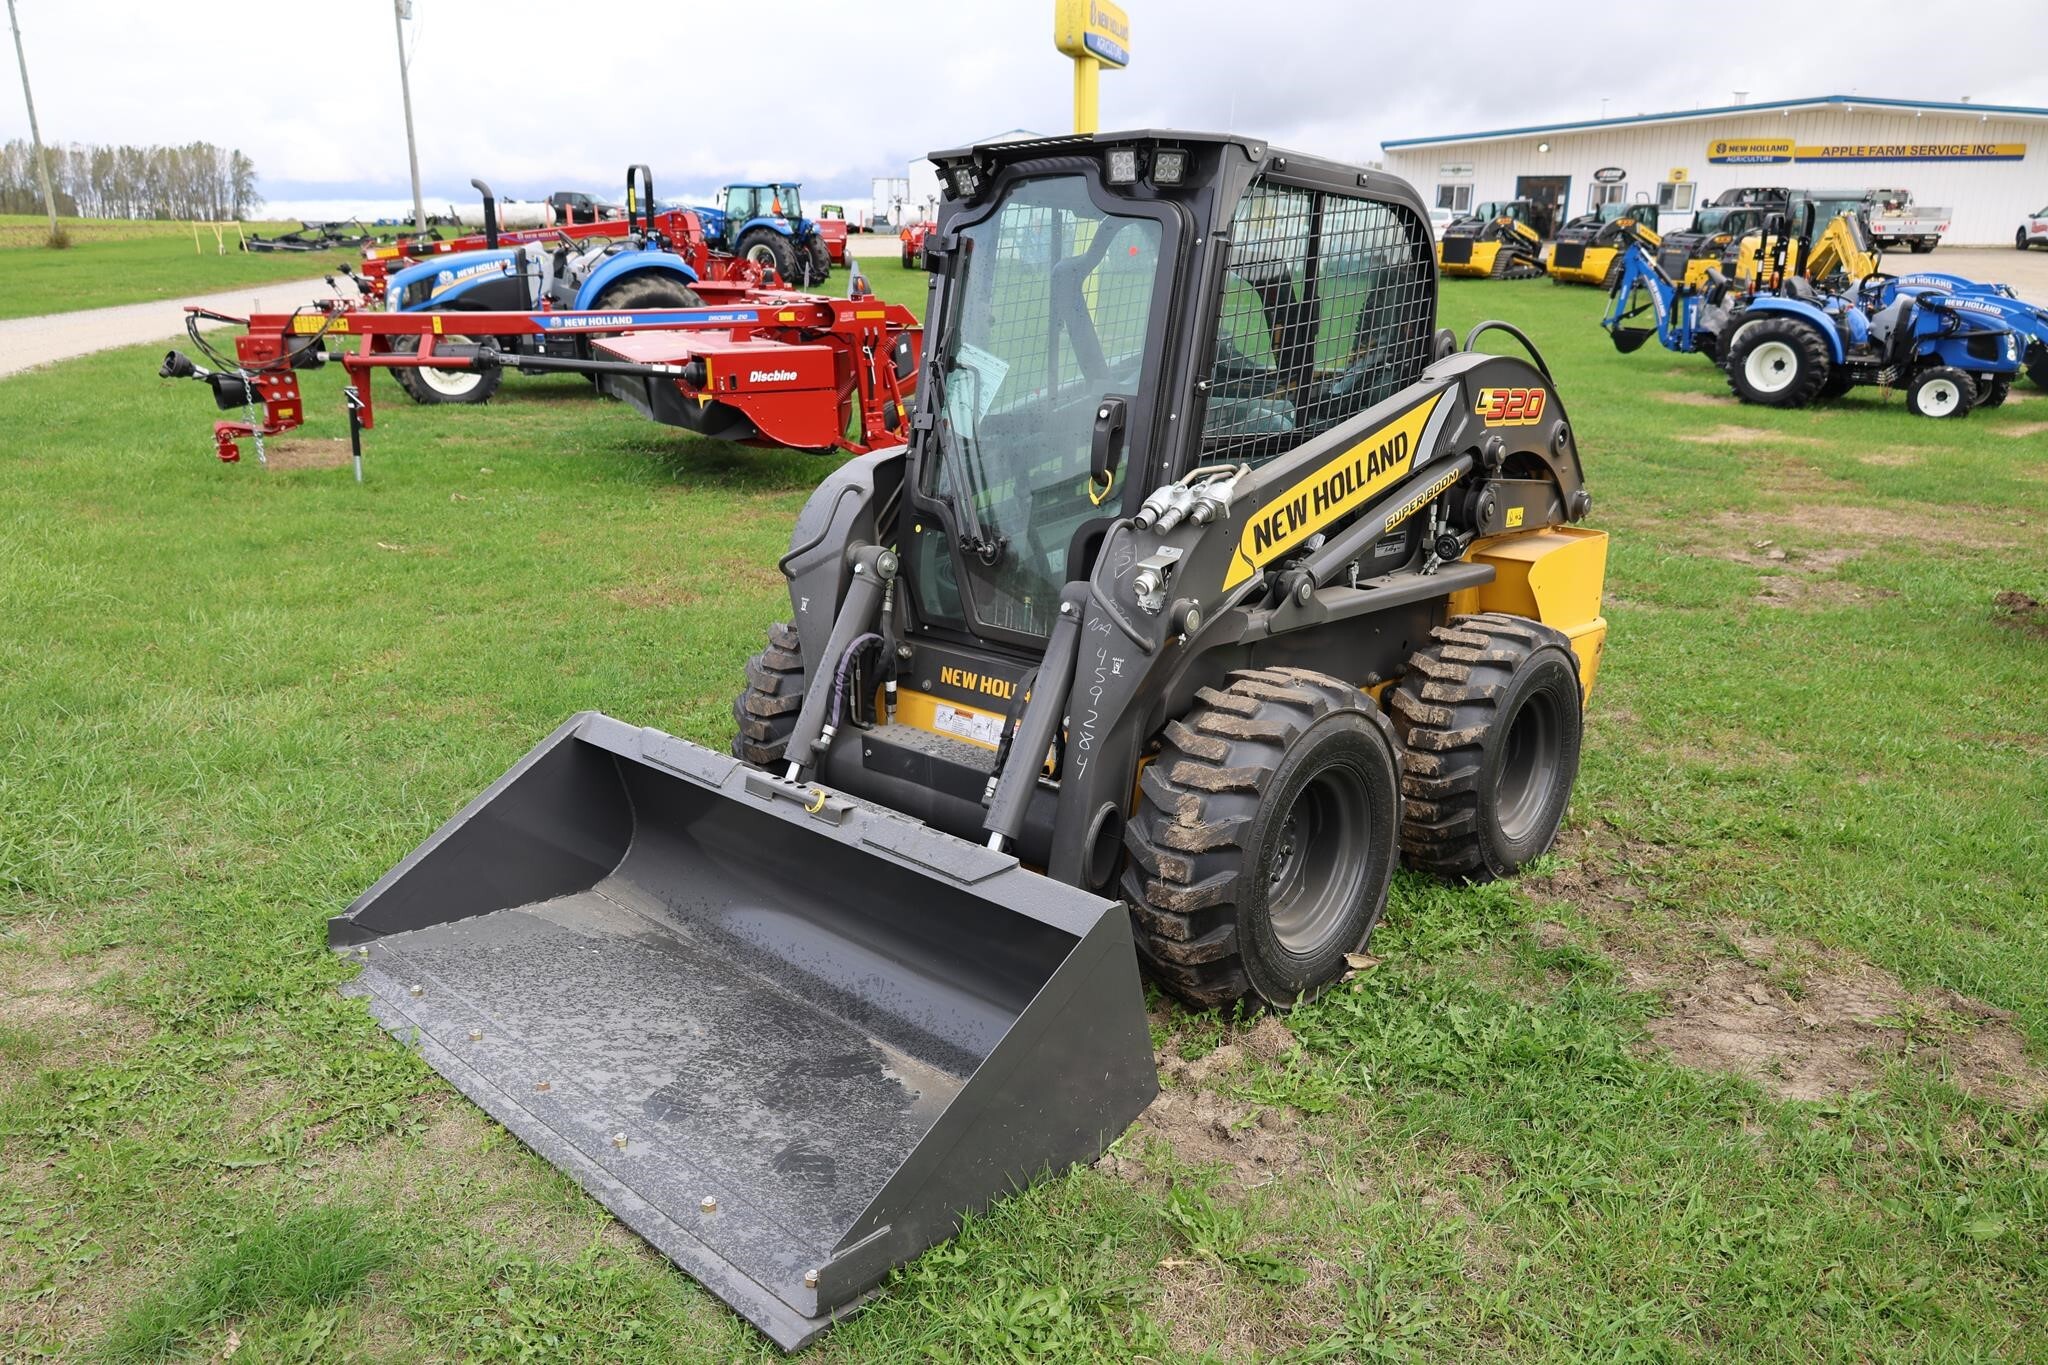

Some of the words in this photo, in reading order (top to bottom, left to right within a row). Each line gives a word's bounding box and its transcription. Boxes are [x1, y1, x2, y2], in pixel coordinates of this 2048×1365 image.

[1750, 144, 1789, 152] HOLLAND
[1821, 146, 1865, 156] APPLE
[1868, 145, 1906, 156] FARM
[1910, 145, 1968, 156] SERVICE
[1972, 144, 1999, 155] INC.
[1726, 155, 1774, 163] AGRICULTURE
[456, 266, 475, 278] NEW
[1898, 276, 1916, 285] NEW
[1916, 277, 1952, 289] HOLLAND
[1944, 299, 1964, 307] NEW
[1964, 300, 2002, 315] HOLLAND
[564, 318, 587, 327] NEW
[588, 316, 633, 326] HOLLAND
[749, 369, 798, 383] Discbine
[1476, 389, 1545, 422] L320
[1252, 492, 1307, 555] NEW
[1312, 431, 1409, 517] HOLLAND
[1385, 493, 1425, 531] SUPER
[1426, 468, 1458, 501] BOOM
[940, 665, 978, 690] NEW
